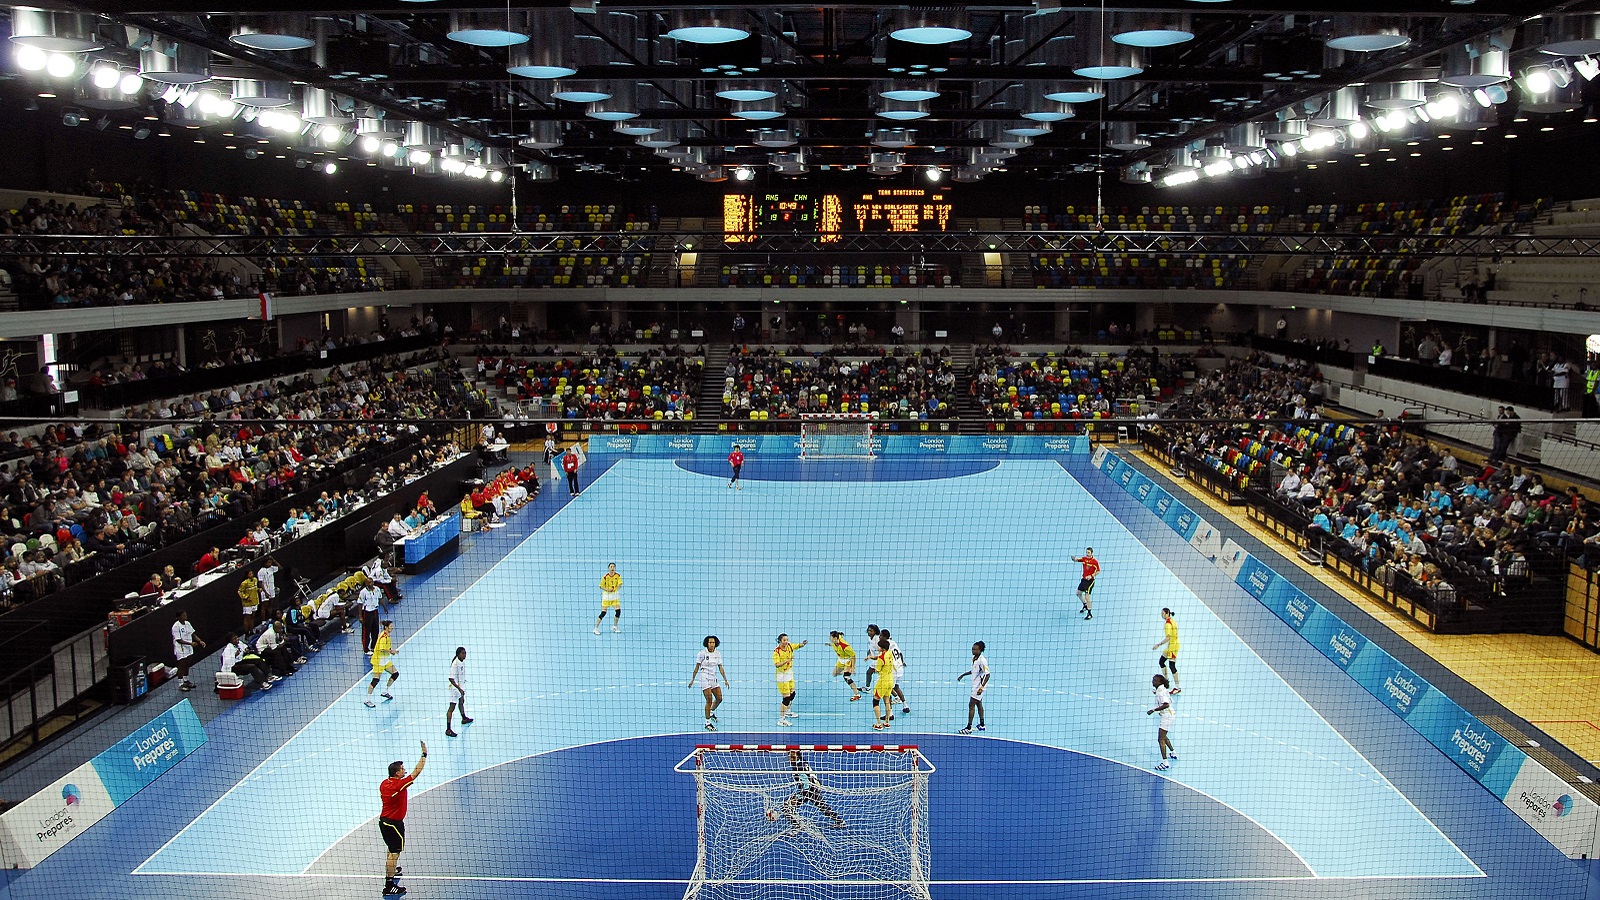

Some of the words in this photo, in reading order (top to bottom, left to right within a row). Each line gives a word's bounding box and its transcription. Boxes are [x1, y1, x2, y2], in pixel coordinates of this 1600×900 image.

[779, 202, 797, 210] 10:49
[1286, 601, 1304, 621] Prepares
[1293, 595, 1308, 612] London
[1330, 635, 1352, 658] Prepares
[1338, 629, 1356, 650] London
[891, 648, 901, 661] 19
[1383, 677, 1411, 705] Prepares
[1394, 671, 1416, 695] London
[135, 727, 169, 753] London
[1451, 729, 1485, 764] Prepares
[1464, 723, 1490, 752] London
[132, 738, 175, 770] Prepares
[165, 748, 178, 760] series
[1468, 760, 1480, 772] series
[1519, 791, 1547, 818] Prepares
[1530, 787, 1550, 810] London
[36, 815, 73, 842] Prepares
[39, 807, 68, 829] London
